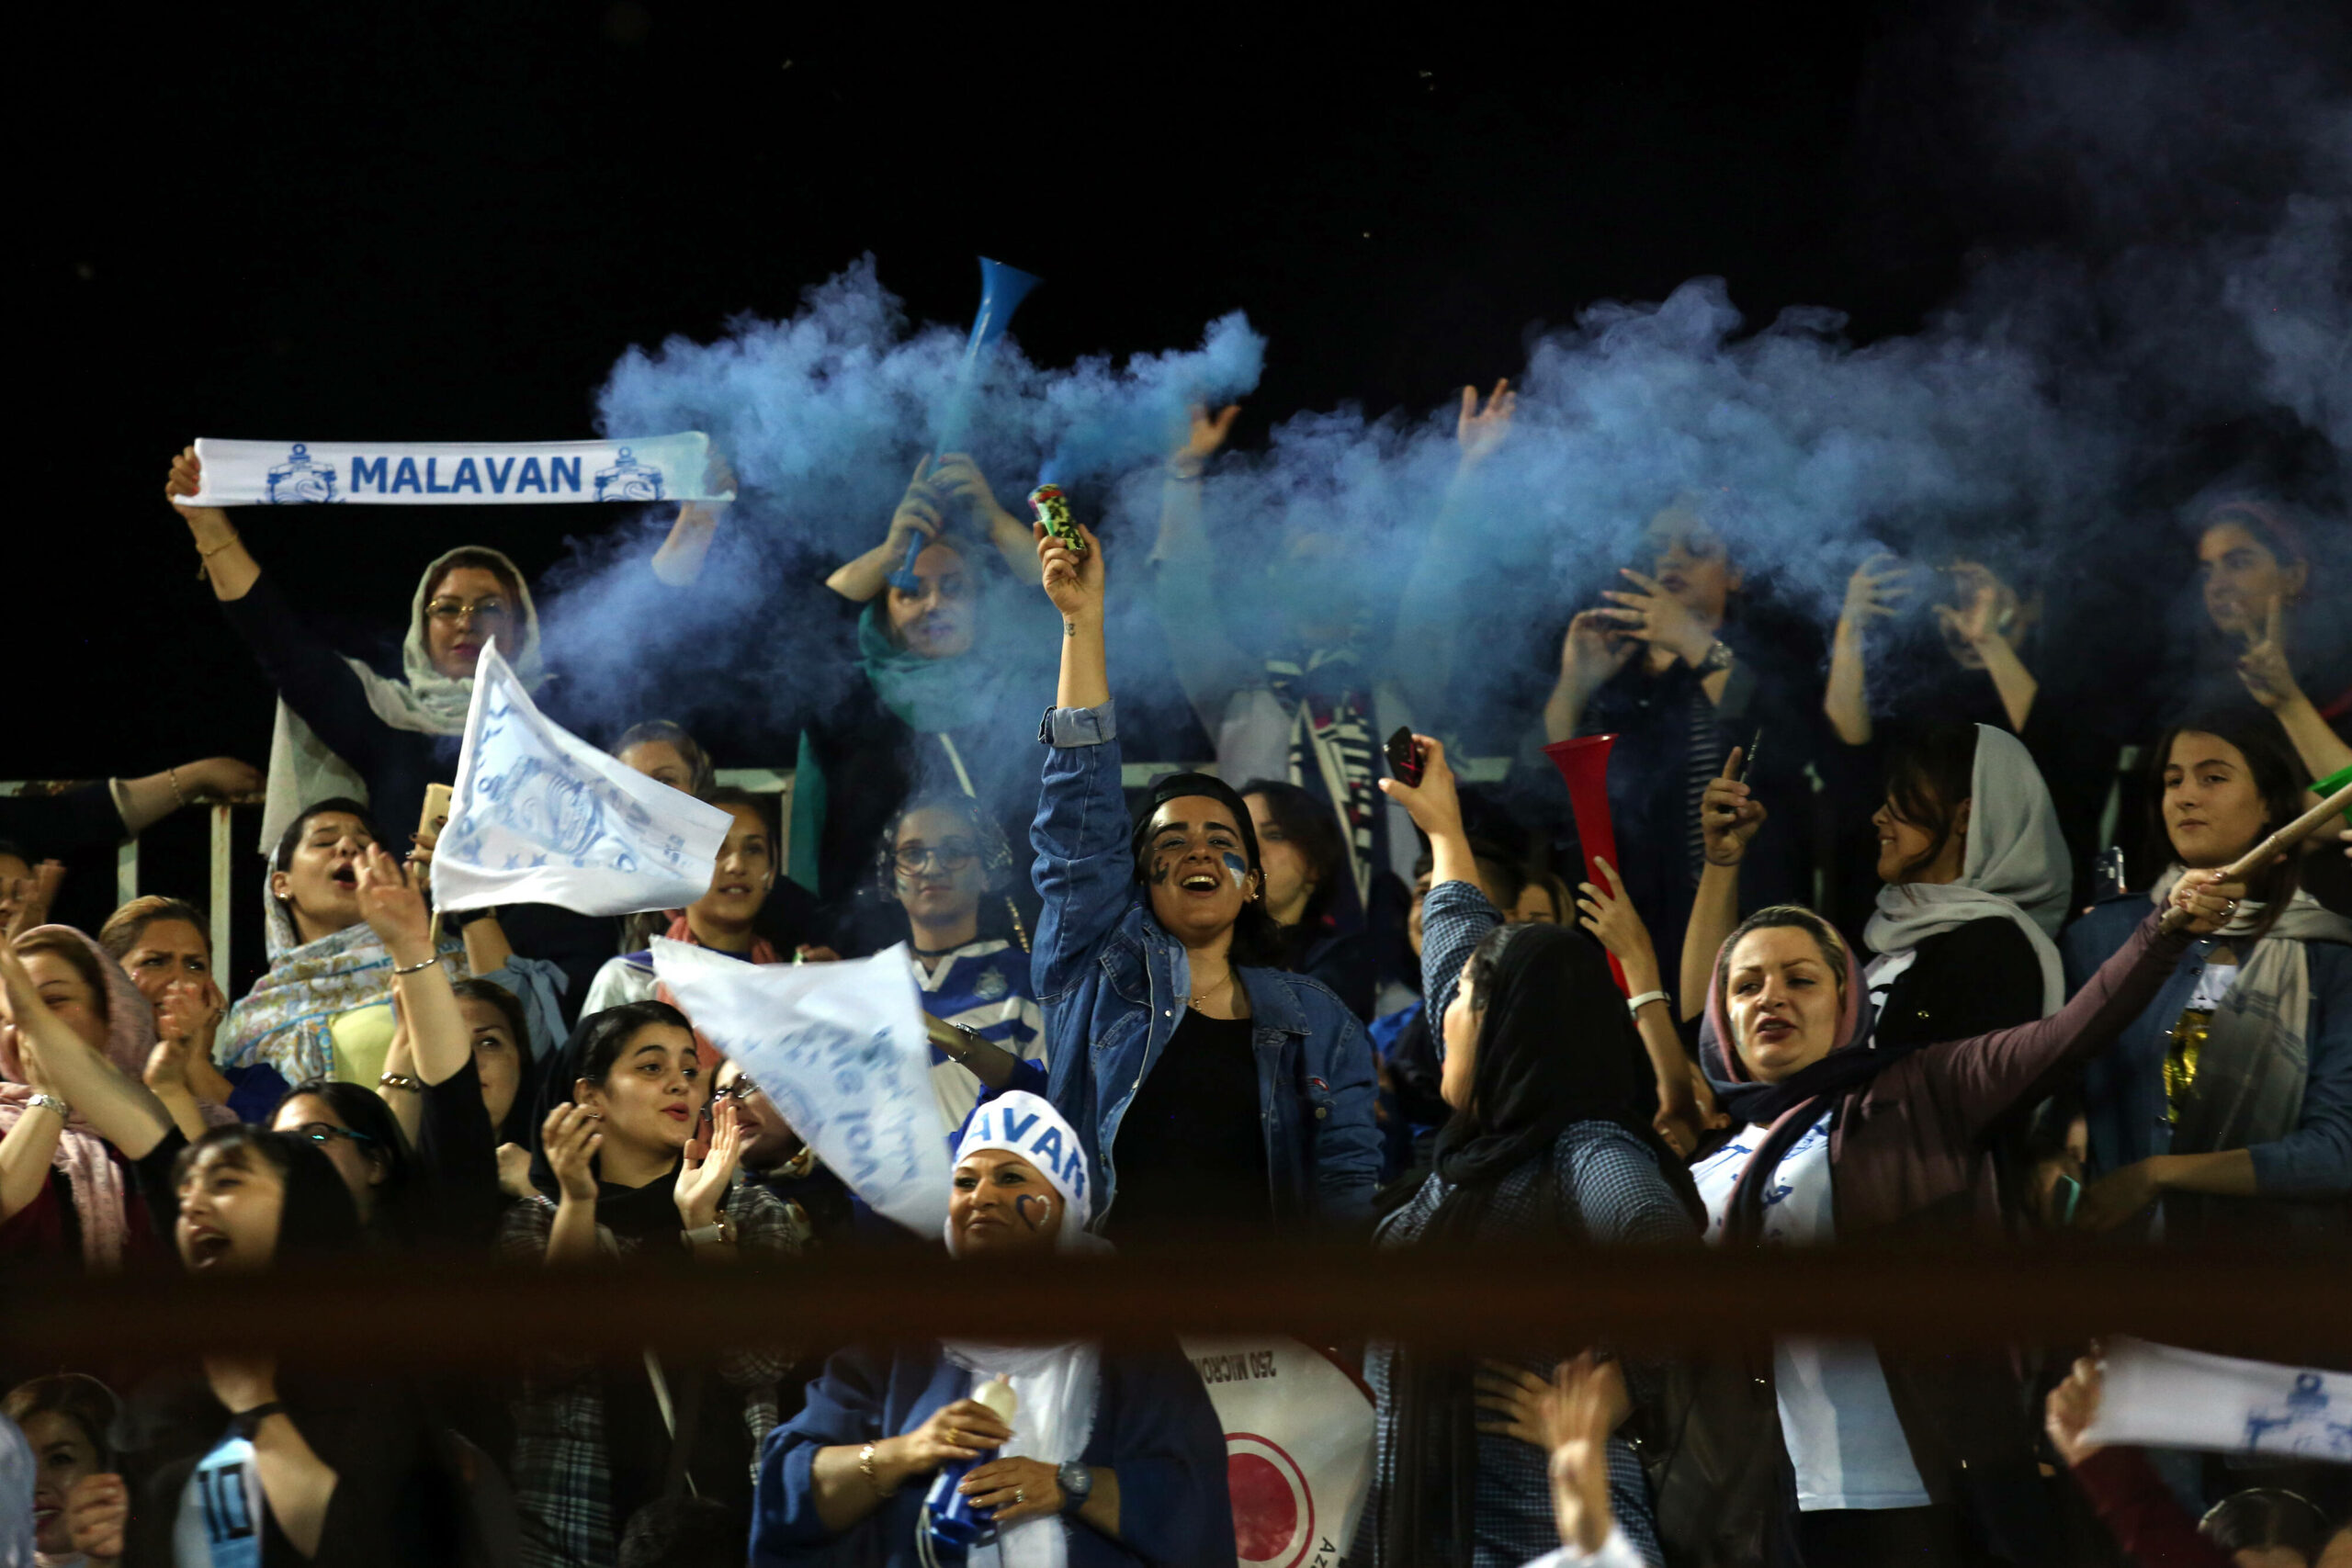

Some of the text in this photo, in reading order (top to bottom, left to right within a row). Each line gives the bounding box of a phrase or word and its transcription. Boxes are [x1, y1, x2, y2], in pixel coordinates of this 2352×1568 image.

[350, 457, 582, 493] MALAVAN
[954, 1108, 1086, 1200] AVAN
[1250, 1350, 1277, 1380] 250
[198, 1462, 254, 1544] 10
